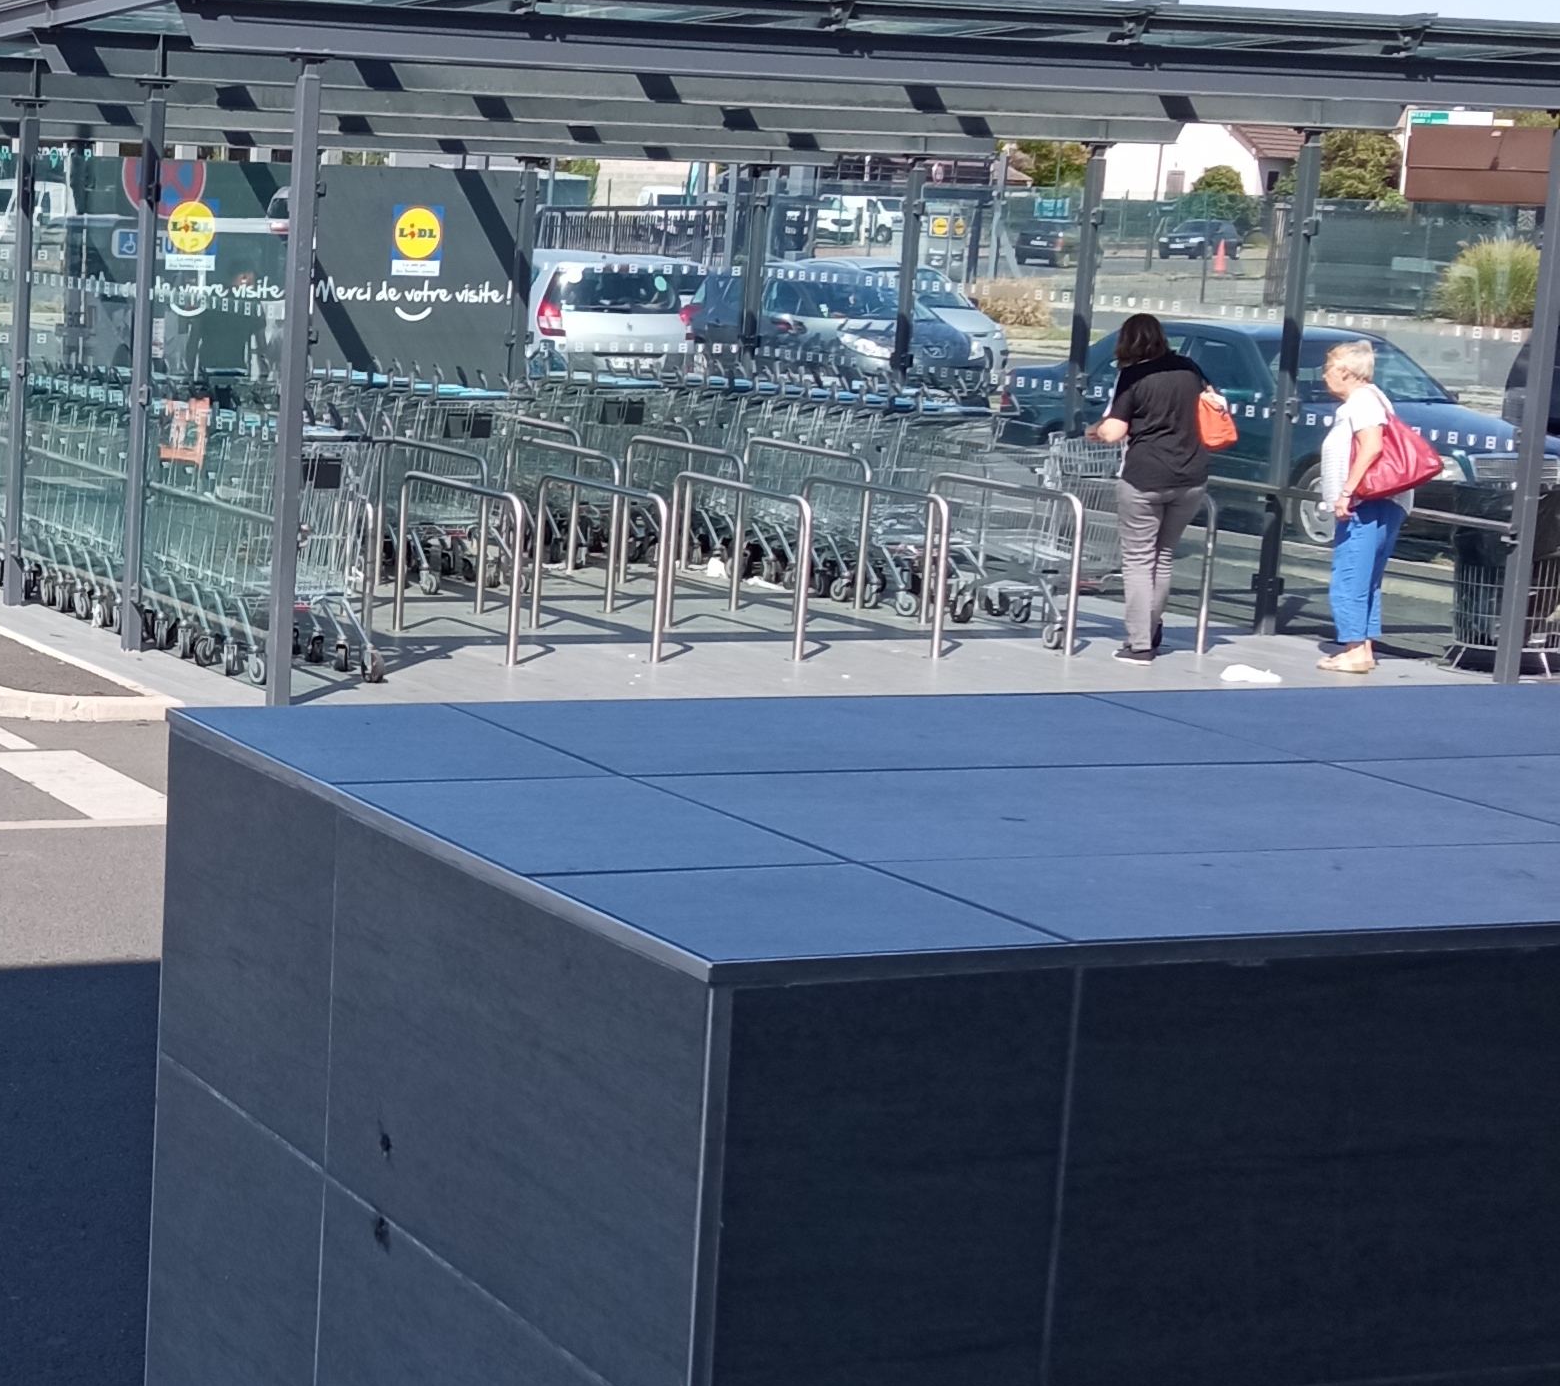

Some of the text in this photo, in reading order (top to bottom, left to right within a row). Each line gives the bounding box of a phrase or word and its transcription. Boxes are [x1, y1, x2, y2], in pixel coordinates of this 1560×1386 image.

[231, 275, 286, 299] visite
[316, 275, 372, 303] Merci
[375, 280, 402, 303] de
[404, 279, 453, 303] votre
